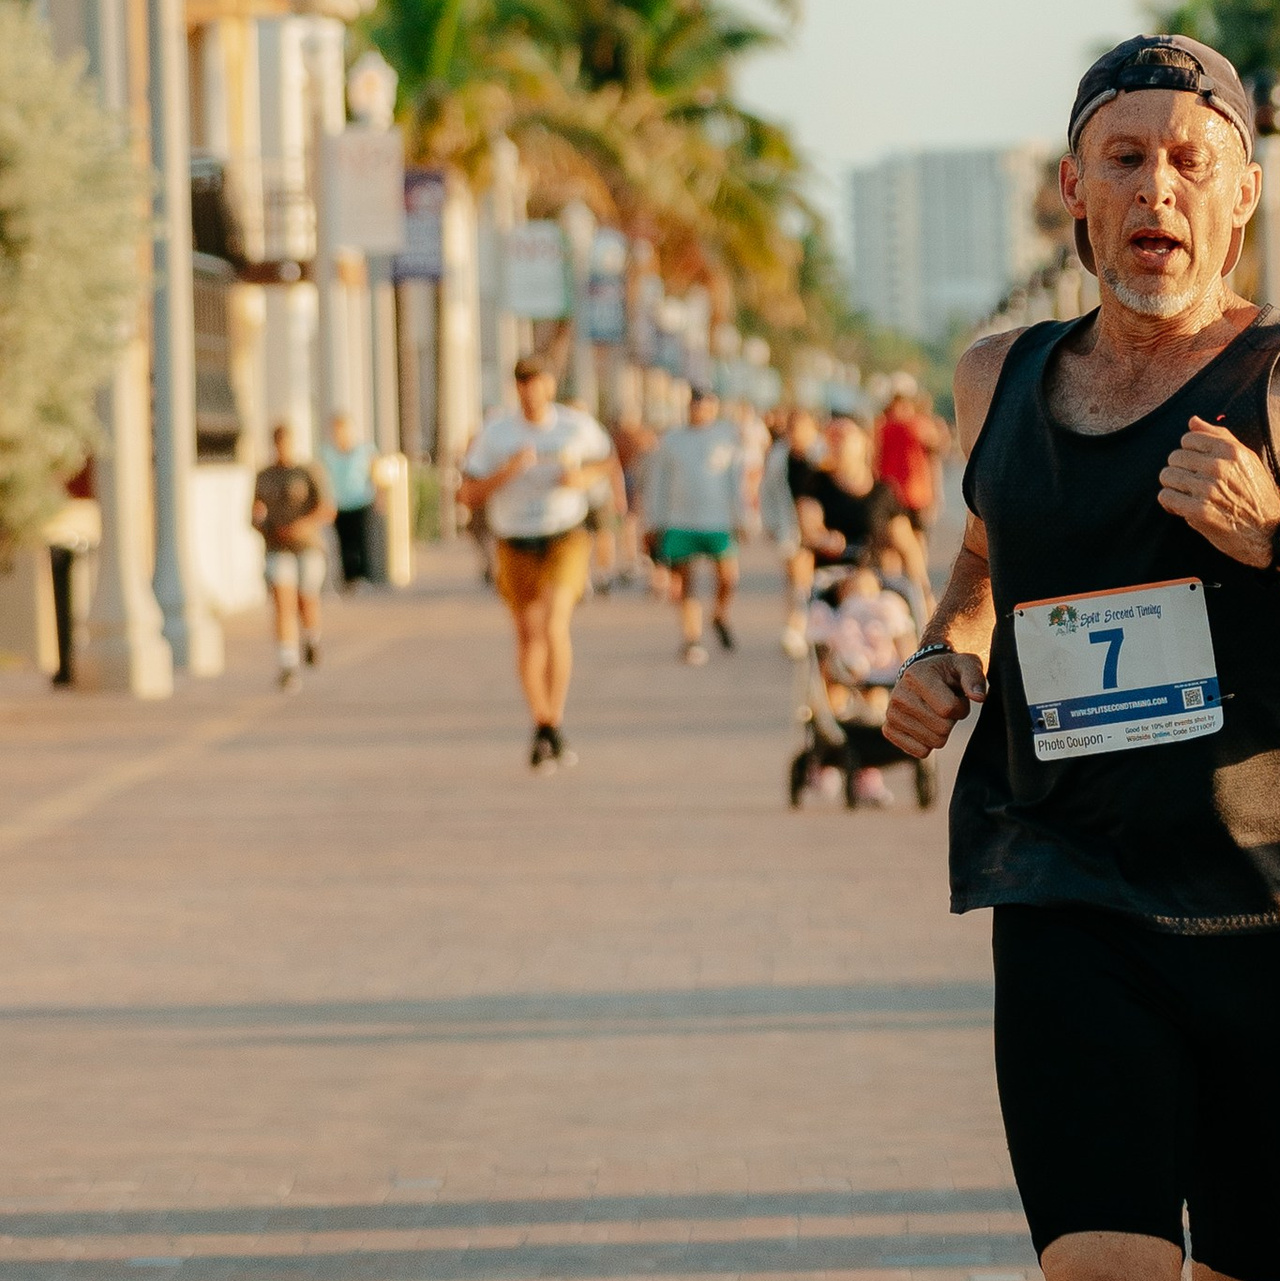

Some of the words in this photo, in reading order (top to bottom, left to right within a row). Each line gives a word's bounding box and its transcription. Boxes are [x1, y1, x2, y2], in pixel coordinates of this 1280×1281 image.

[1080, 612, 1100, 628] Split
[1104, 608, 1135, 624] Second
[1136, 604, 1162, 620] Timing
[1089, 627, 1125, 690] 7
[1071, 697, 1168, 717] WWW.SPLITSECONDTIMING.COM
[1174, 719, 1193, 727] events
[1038, 738, 1066, 752] Photo
[1066, 733, 1104, 749] Coupon
